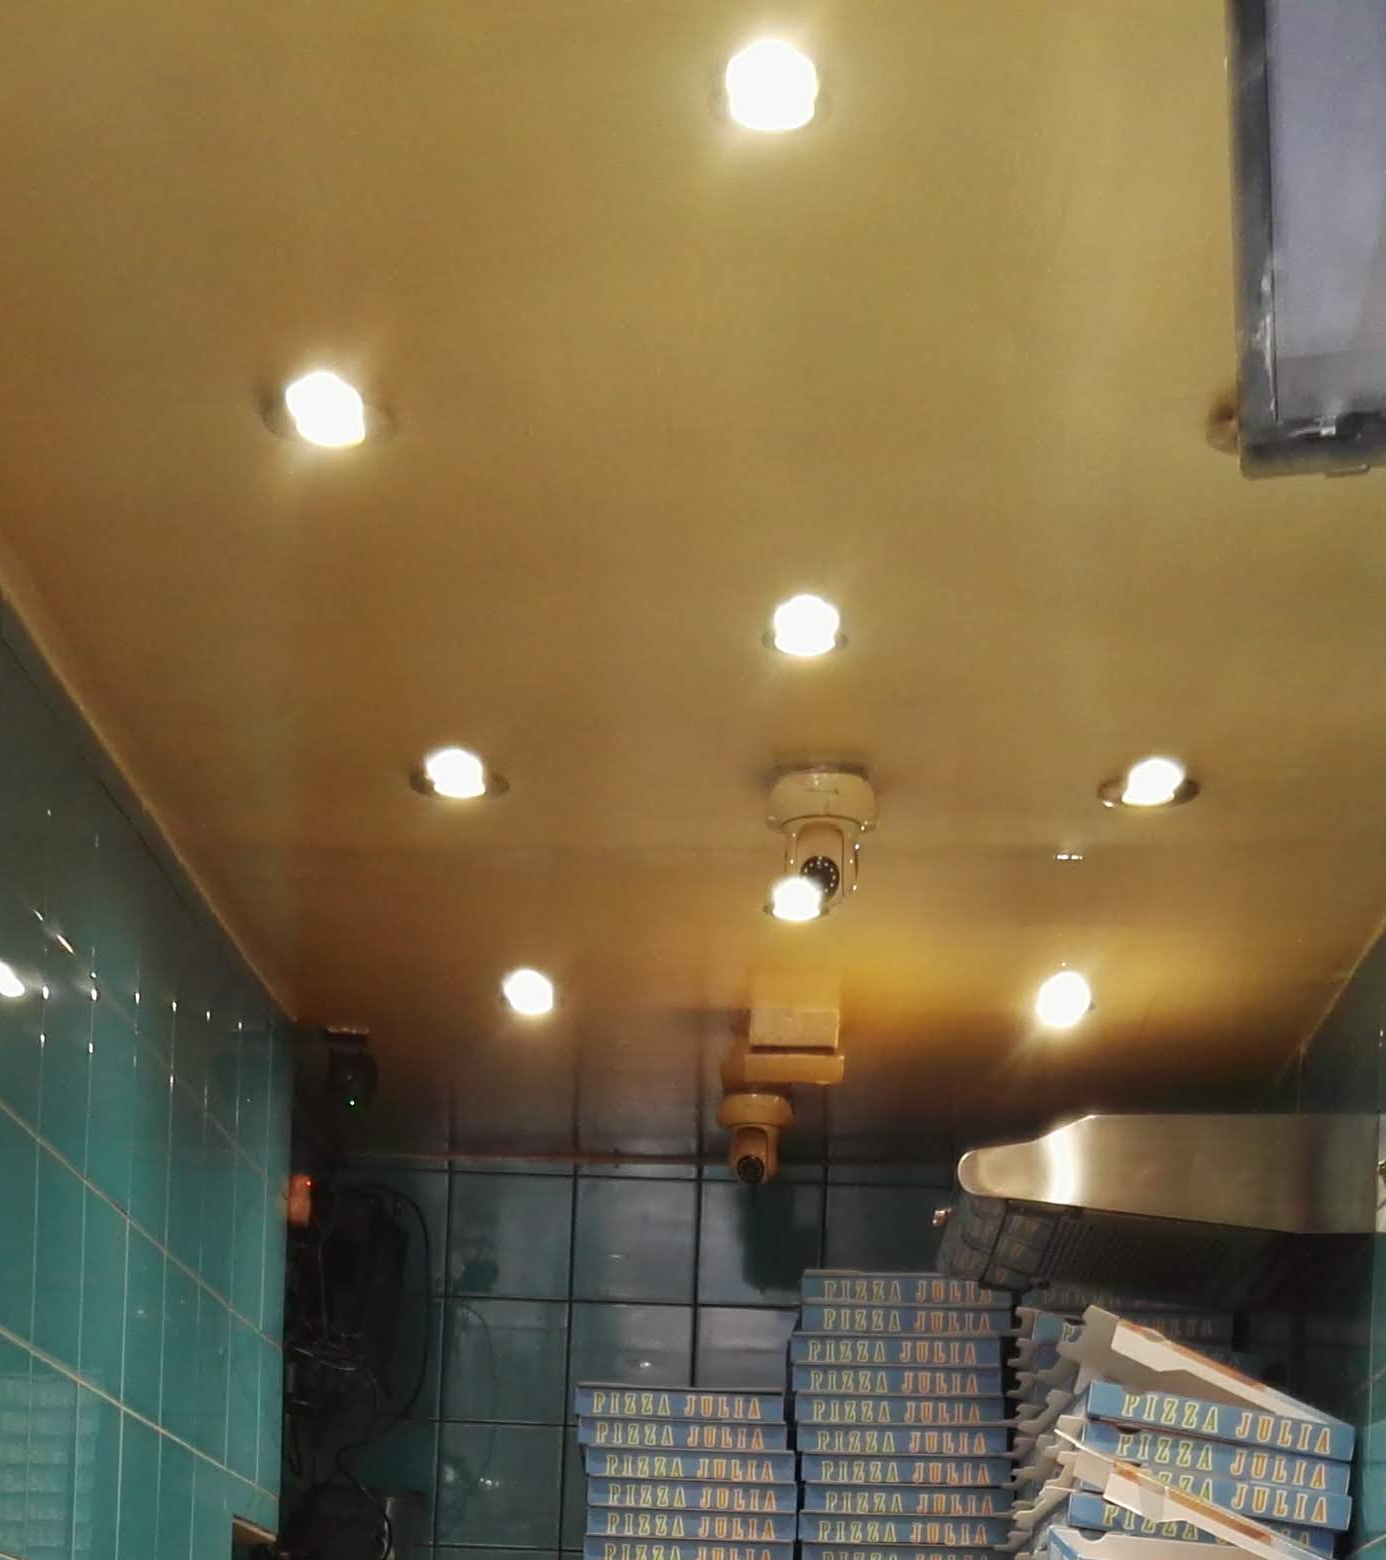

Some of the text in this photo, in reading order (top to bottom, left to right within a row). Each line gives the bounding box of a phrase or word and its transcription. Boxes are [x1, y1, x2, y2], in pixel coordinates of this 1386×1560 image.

[824, 1280, 992, 1301] PIZZA JULIA
[824, 1309, 990, 1333] PIZZA JULIA
[808, 1341, 976, 1364] PIZZA JULIA
[810, 1370, 978, 1394] PIZZA JULIA
[593, 1391, 761, 1419] PIZZA JULIA
[813, 1400, 980, 1424] PIZZA JULIA
[596, 1422, 763, 1449] PIZZA JULIA
[1122, 1393, 1331, 1455] PIZZA JULIA
[817, 1430, 986, 1454] PIZZA JULIA
[606, 1454, 773, 1481] PIZZA JULIA
[821, 1461, 989, 1484] PIZZA JULIA
[1116, 1433, 1326, 1490] PIZZA JULIA
[608, 1484, 777, 1511] PIZZA JULIA
[825, 1492, 993, 1515] PIZZA JULIA
[1230, 1483, 1328, 1524] JULIA
[607, 1512, 775, 1540] PIZZA JULIA
[818, 1520, 987, 1545] PIZZA JULIA
